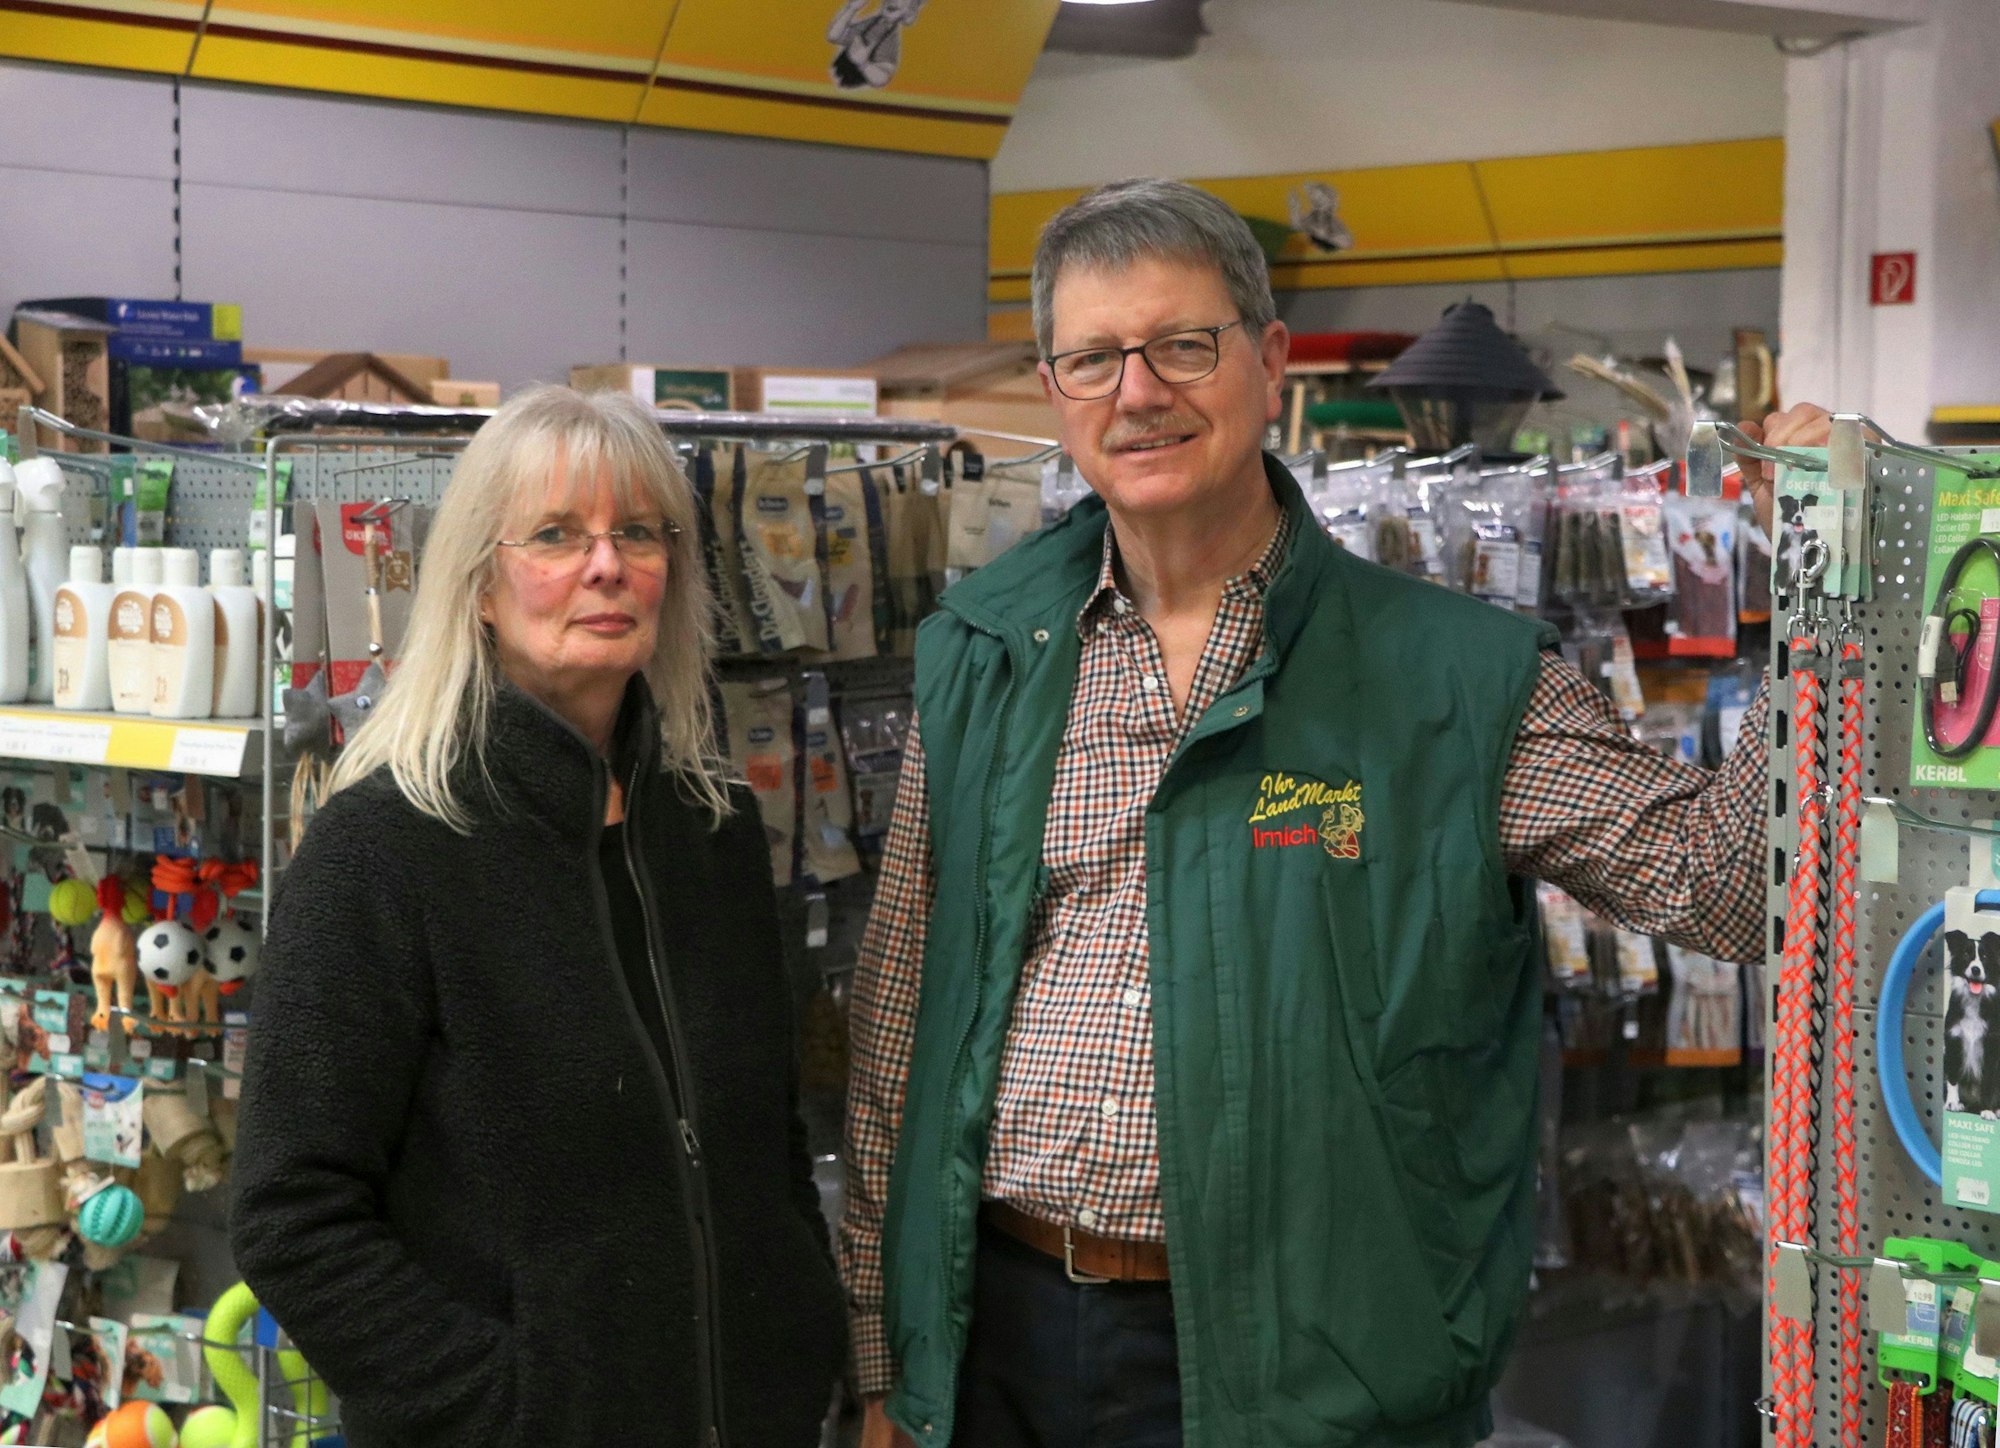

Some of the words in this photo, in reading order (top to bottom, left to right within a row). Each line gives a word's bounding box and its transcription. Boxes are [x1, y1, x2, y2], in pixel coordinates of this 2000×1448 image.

[1938, 489, 1971, 507] Maxi
[1916, 764, 1967, 782] KERBL
[1260, 772, 1296, 799] Ihr
[1947, 1118, 1972, 1131] MAXI
[1974, 1123, 1995, 1134] SAFE
